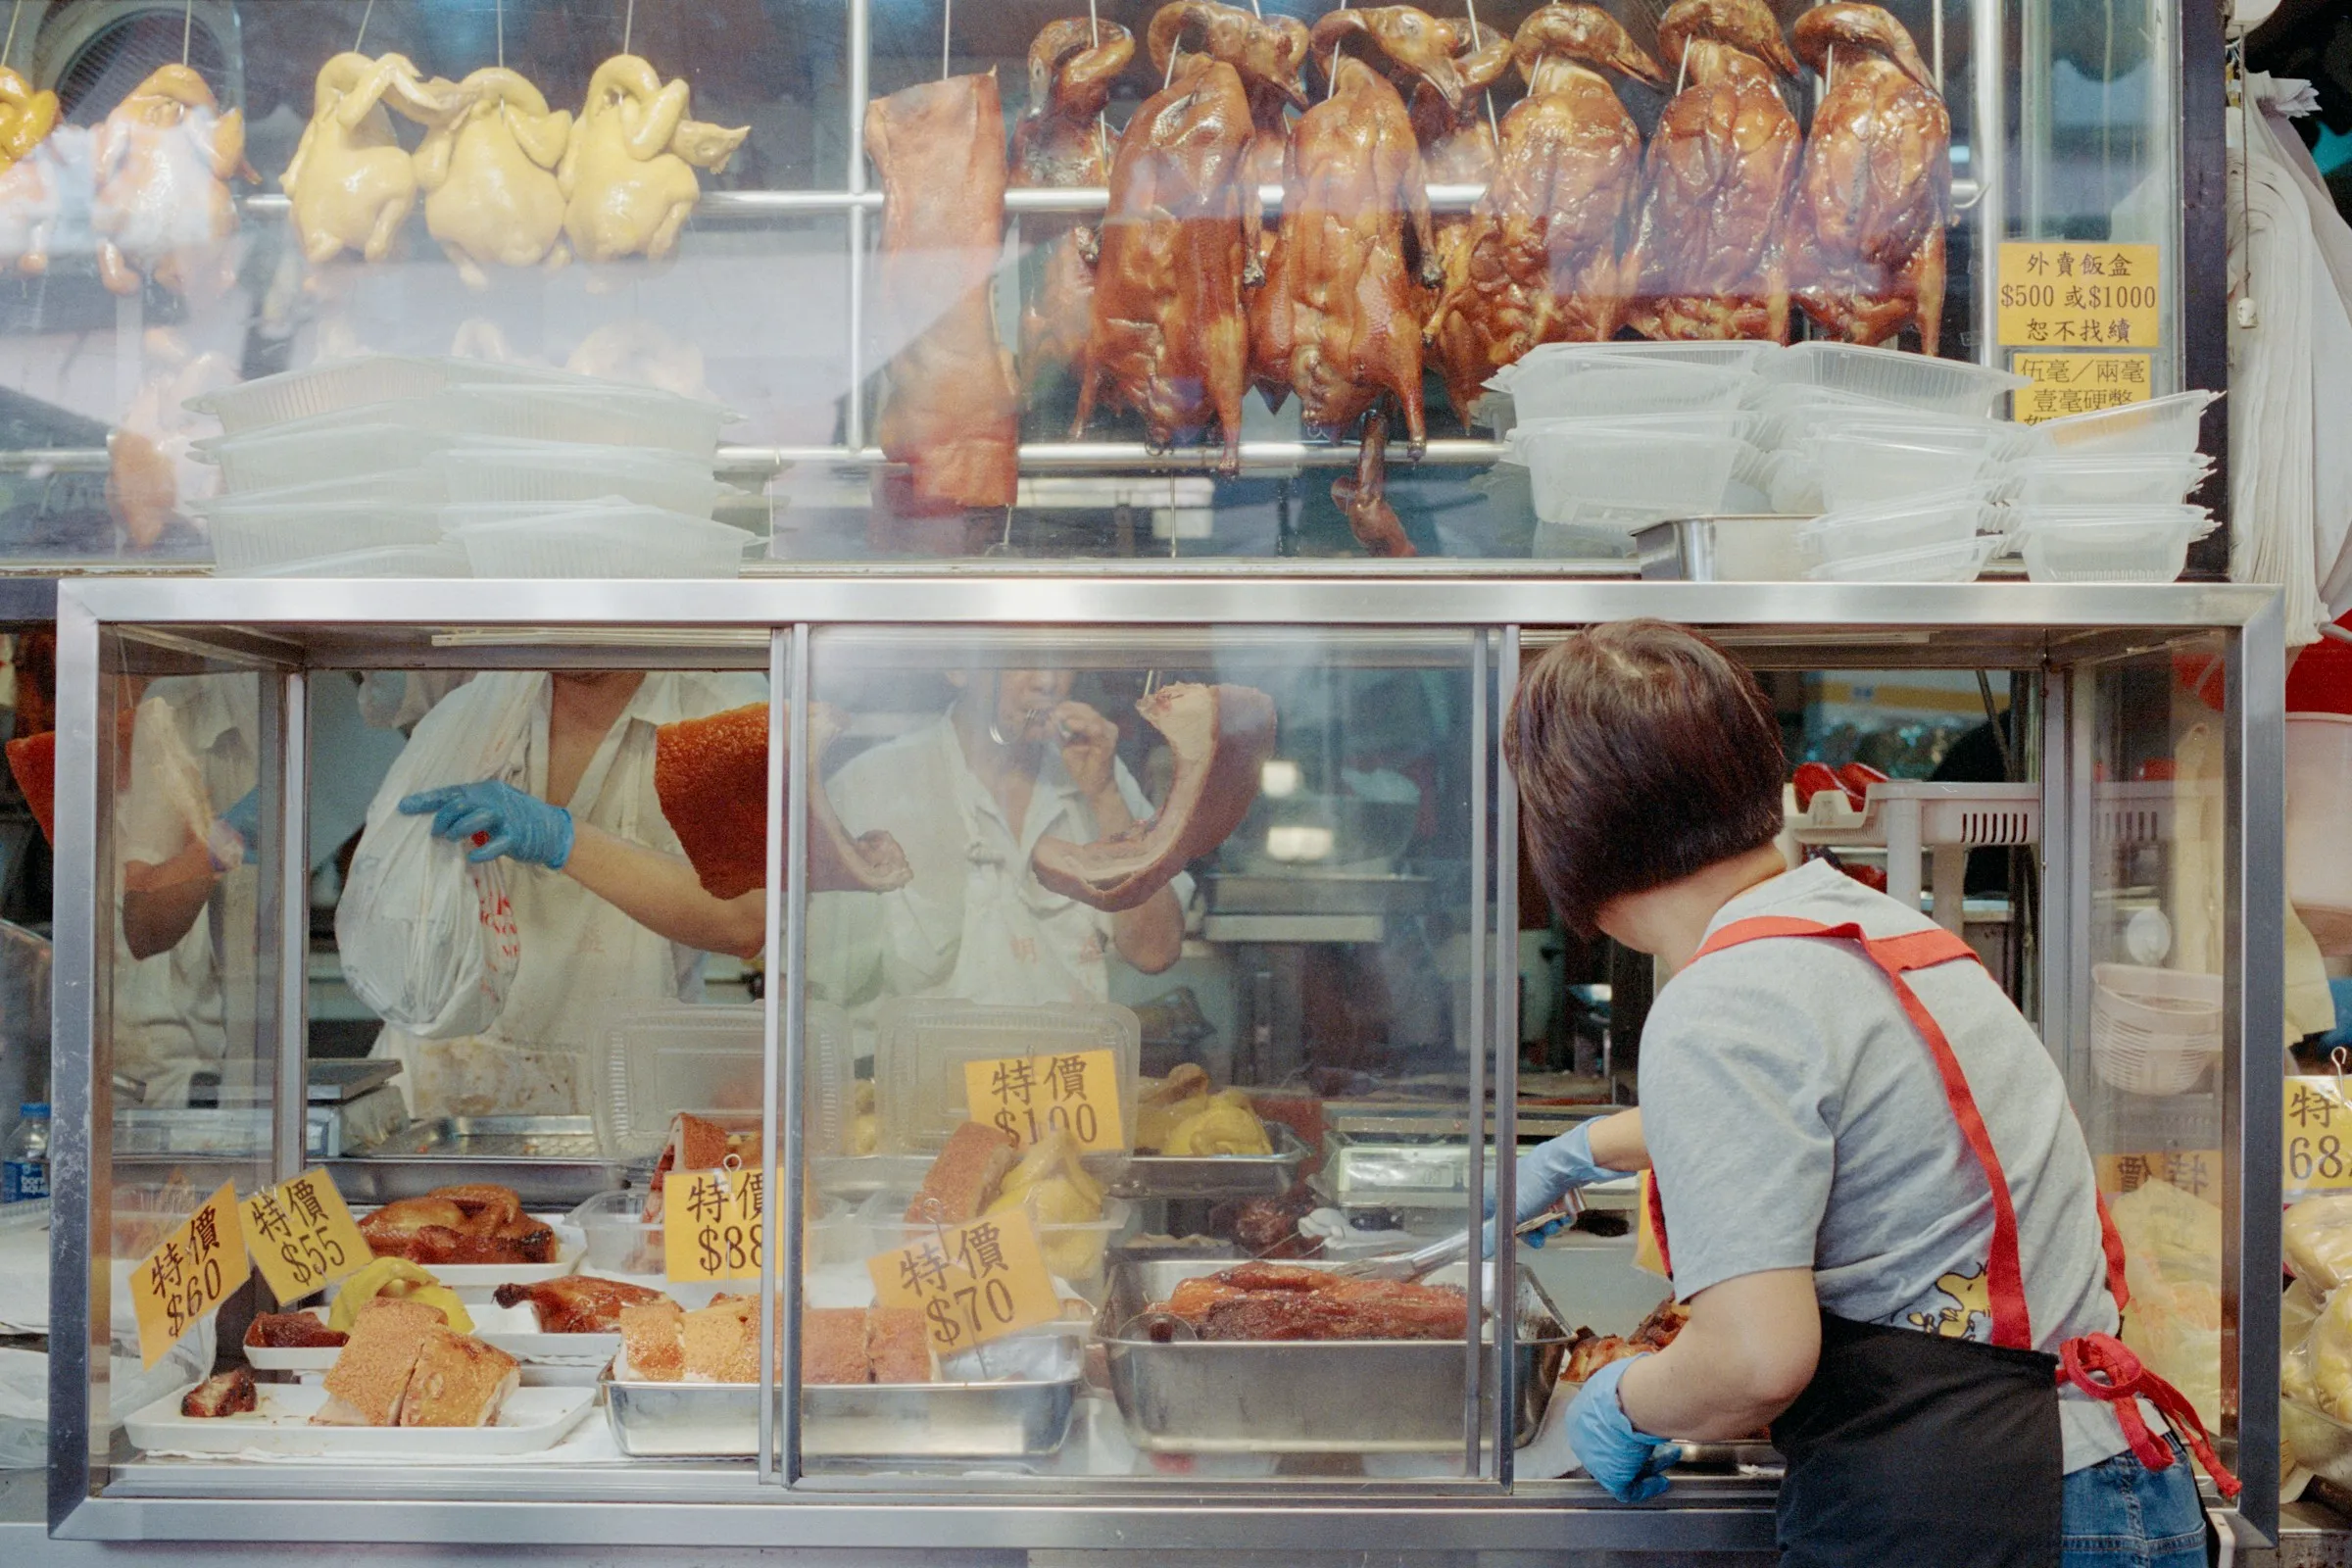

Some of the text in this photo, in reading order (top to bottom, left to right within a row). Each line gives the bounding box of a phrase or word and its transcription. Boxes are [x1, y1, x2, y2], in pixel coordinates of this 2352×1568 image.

[2027, 251, 2132, 277] 外賣飯盒
[2001, 284, 2054, 308] $500
[2027, 318, 2131, 343] 恕不找續
[991, 1054, 1087, 1105] 特價
[994, 1103, 1097, 1149] $100
[2289, 1085, 2339, 1128] 特
[2289, 1135, 2352, 1180] 68
[251, 1179, 329, 1243] 特價
[687, 1172, 762, 1223] 特價
[151, 1204, 220, 1298] 特價
[281, 1225, 345, 1287] $55
[698, 1224, 762, 1276] $88
[900, 1221, 1009, 1298] 特價
[167, 1258, 221, 1338] $60
[926, 1278, 1014, 1346] $70
